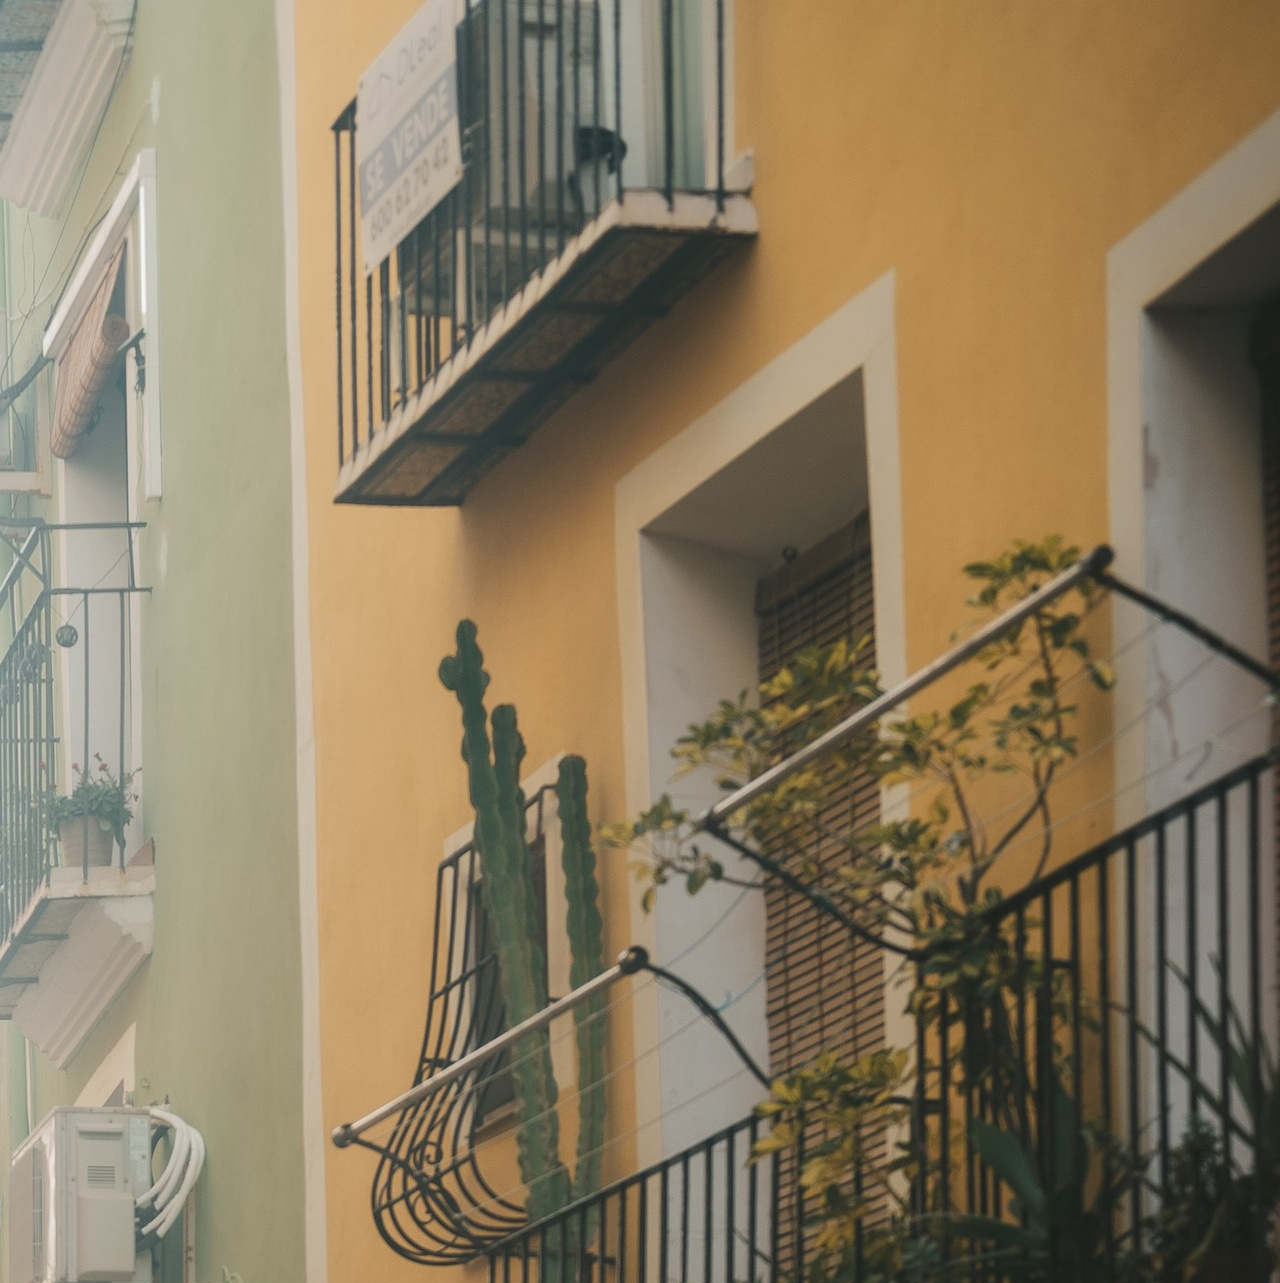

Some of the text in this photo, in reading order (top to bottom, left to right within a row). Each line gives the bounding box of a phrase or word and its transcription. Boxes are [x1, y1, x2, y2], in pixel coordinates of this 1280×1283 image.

[365, 150, 384, 202] SE
[391, 79, 449, 169] VENDE
[371, 198, 392, 242] 600
[396, 177, 411, 216] 62
[414, 157, 430, 198] 70
